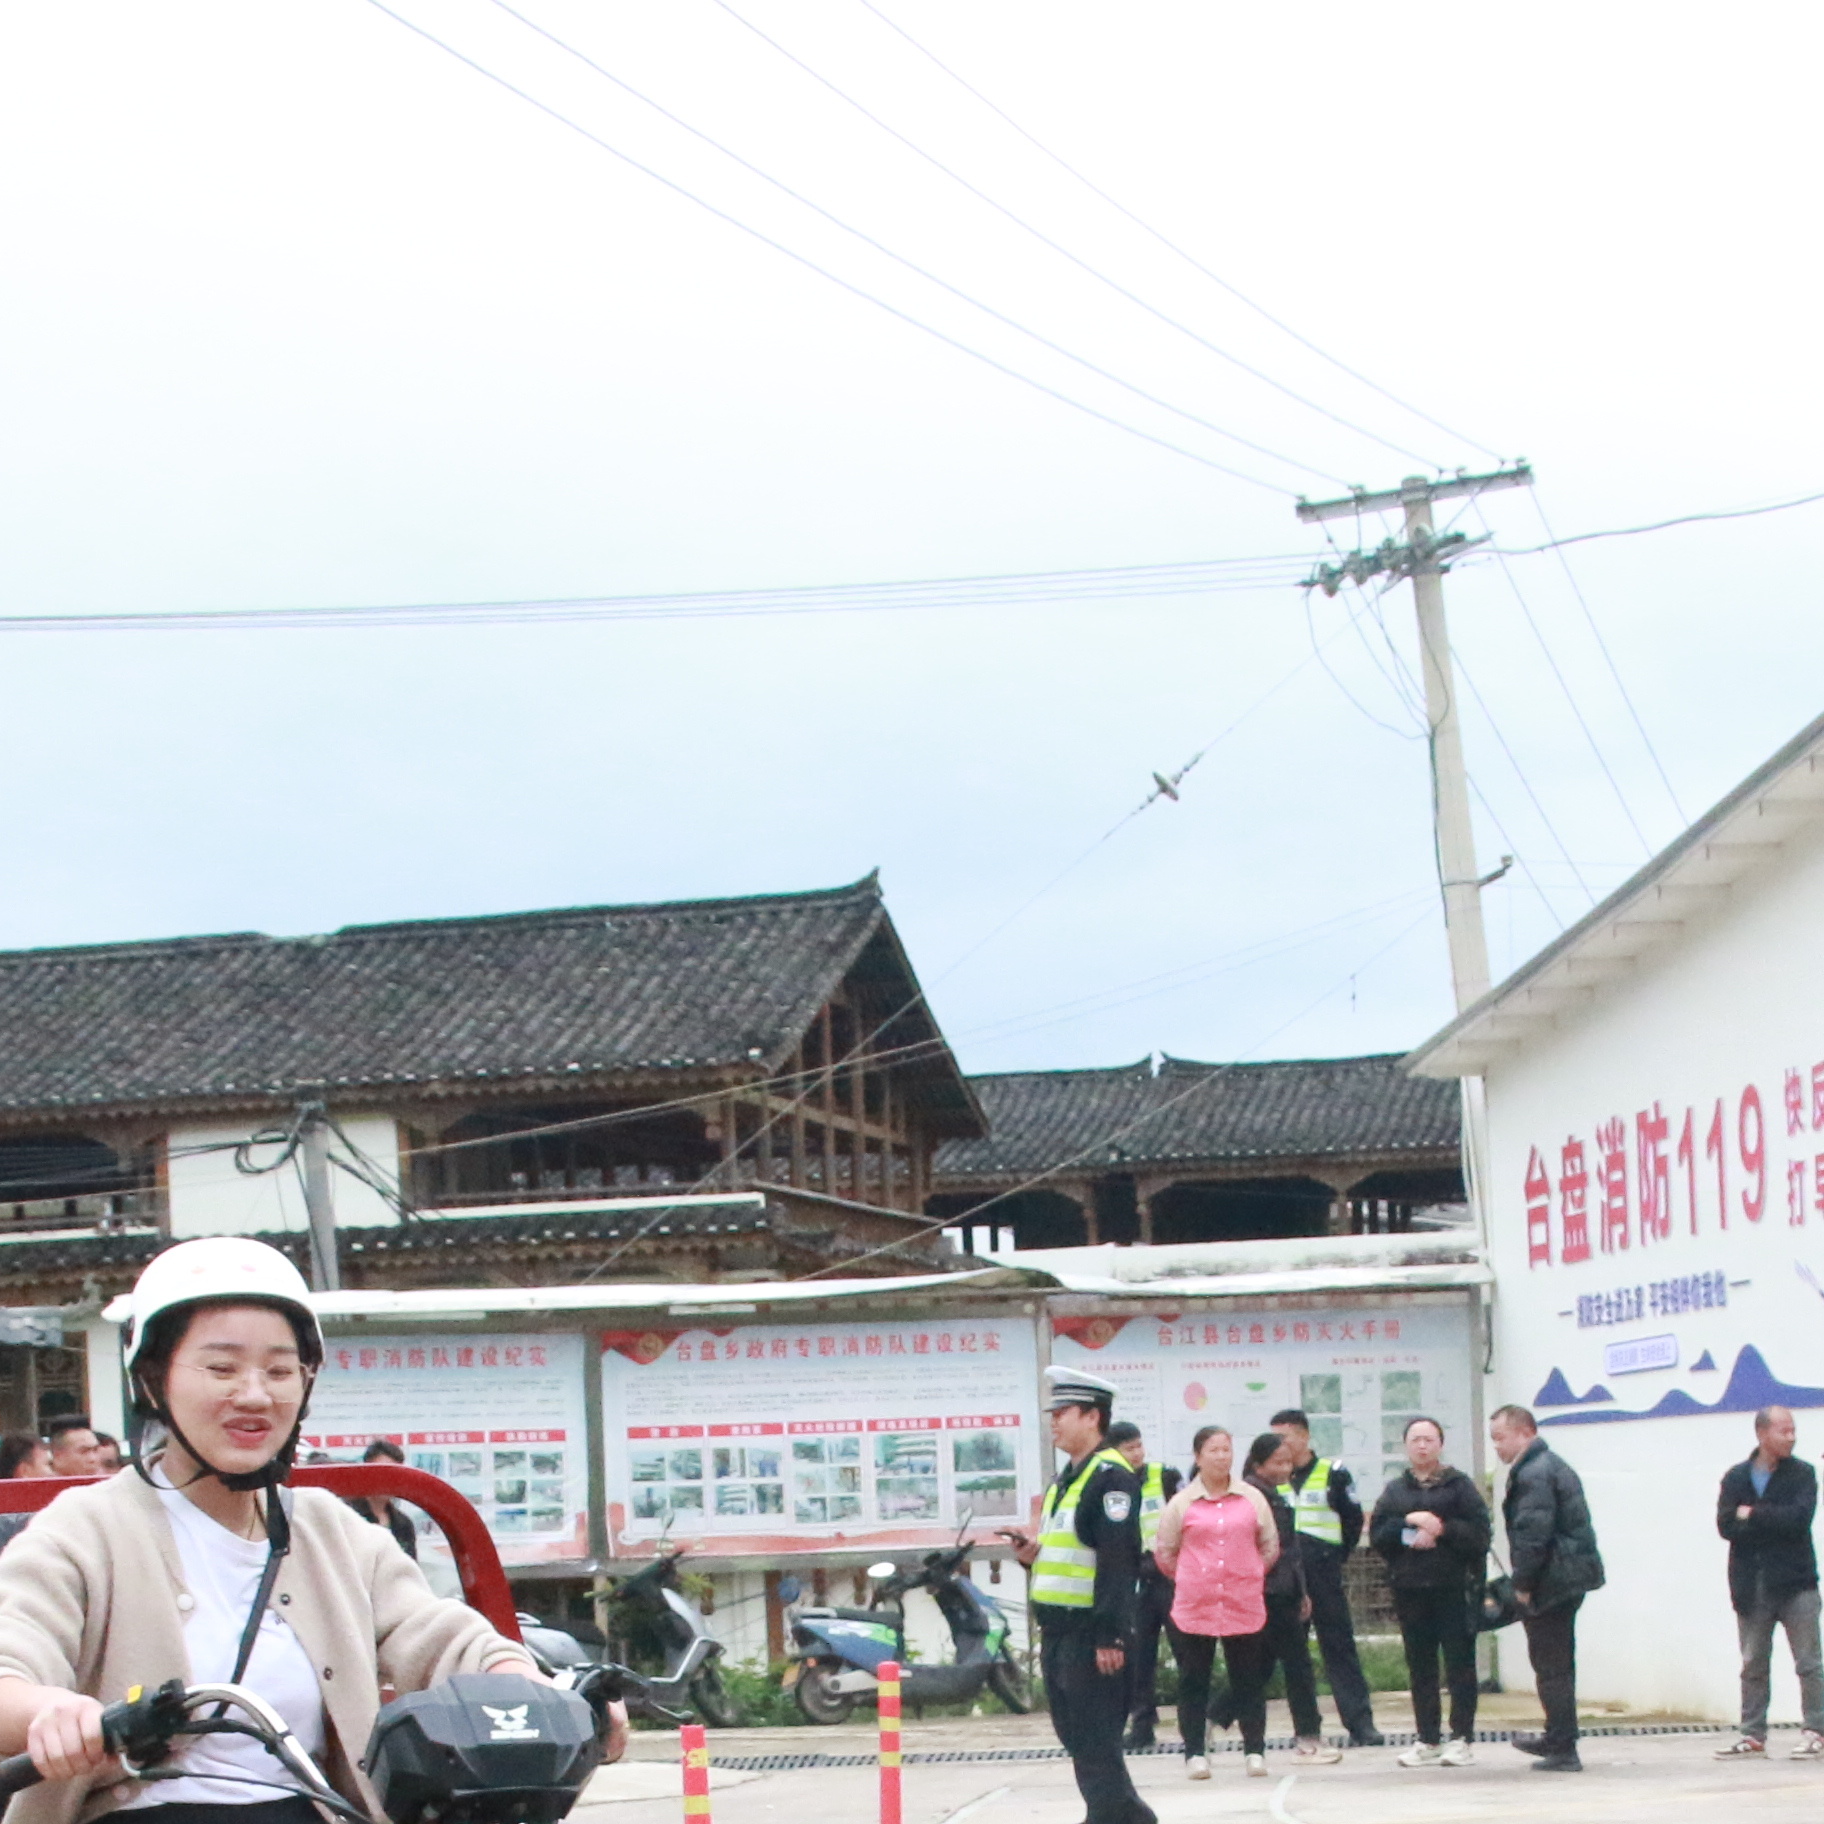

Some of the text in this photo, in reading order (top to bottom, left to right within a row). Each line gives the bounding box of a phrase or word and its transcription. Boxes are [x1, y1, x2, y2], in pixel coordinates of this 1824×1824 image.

[1523, 1084, 1766, 1270] 台盘消防119
[323, 1345, 548, 1370] 专职消防队建设纪实
[675, 1331, 1002, 1362] 台盘乡政府专职消防队建设纪实
